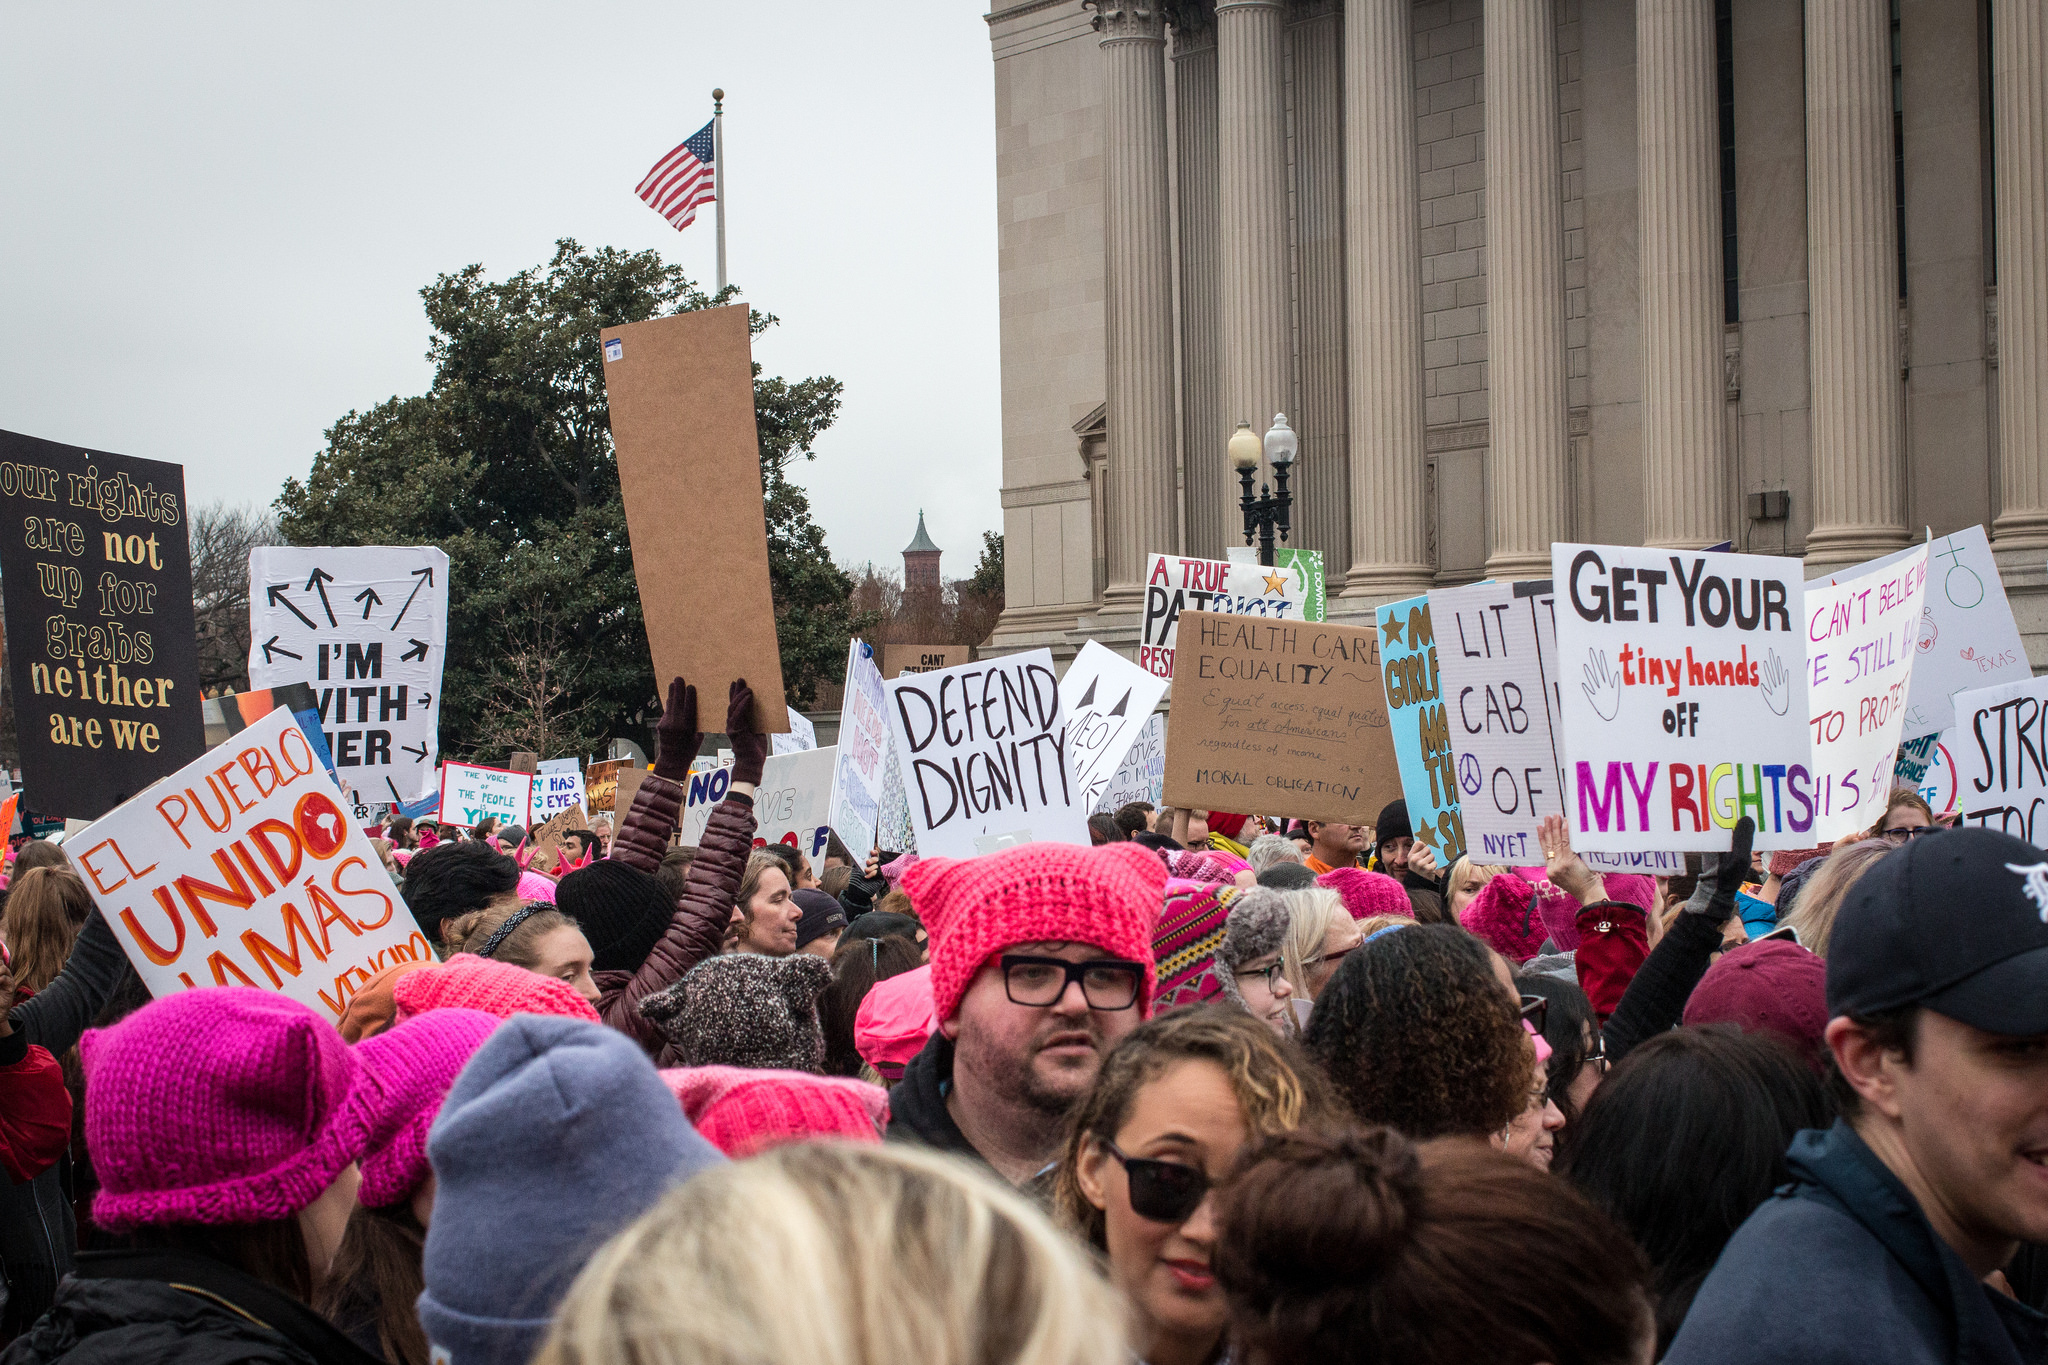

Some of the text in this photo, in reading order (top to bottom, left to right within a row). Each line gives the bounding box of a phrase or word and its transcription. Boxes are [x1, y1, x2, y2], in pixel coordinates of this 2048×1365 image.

[0, 462, 180, 527] our rights
[24, 515, 164, 571] are not
[37, 561, 157, 617] up for
[1149, 557, 1232, 594] A TRUE
[1569, 550, 1667, 624] GET
[1669, 556, 1792, 632] YOUR
[1314, 571, 1324, 623] DOWNTO
[1809, 556, 1929, 642] CAN'T BELIEVE
[46, 614, 154, 665] grabs
[920, 653, 946, 667] CANT
[1200, 617, 1382, 667] HEALTH CARE
[1805, 631, 1896, 688] E STILL
[318, 641, 383, 681] I'M
[1199, 655, 1334, 685] EQUALITY
[1618, 642, 1760, 698] tiny hands
[1972, 649, 2017, 673] TEXAS
[31, 658, 175, 709] neither
[894, 663, 1060, 754] DEFEND
[1202, 688, 1265, 716] Equal
[1313, 705, 1344, 721] equal
[1348, 709, 1389, 729] quality
[1219, 715, 1348, 738] for all Americans
[1662, 701, 1700, 738] OFF
[1809, 710, 1845, 745] TO
[50, 712, 161, 754] are we
[1196, 737, 1328, 762] regardless of income
[1972, 696, 2048, 793] STR
[464, 771, 508, 783] THE VOICE
[549, 776, 575, 792] HAS
[688, 768, 730, 808] NO
[911, 725, 1071, 831] DIGNITY
[1196, 769, 1361, 801] MORAL OBLIGATION
[1491, 767, 1544, 817] OF
[1575, 760, 1814, 833] MY RIGHTS
[79, 726, 314, 896] EL PUEBLO
[458, 788, 515, 808] THE PEOPLE
[480, 803, 487, 811] IS
[547, 792, 581, 809] EYES
[1483, 832, 1528, 859] NYET
[1579, 850, 1679, 869] RESIDENT
[118, 791, 348, 967] UNIDO
